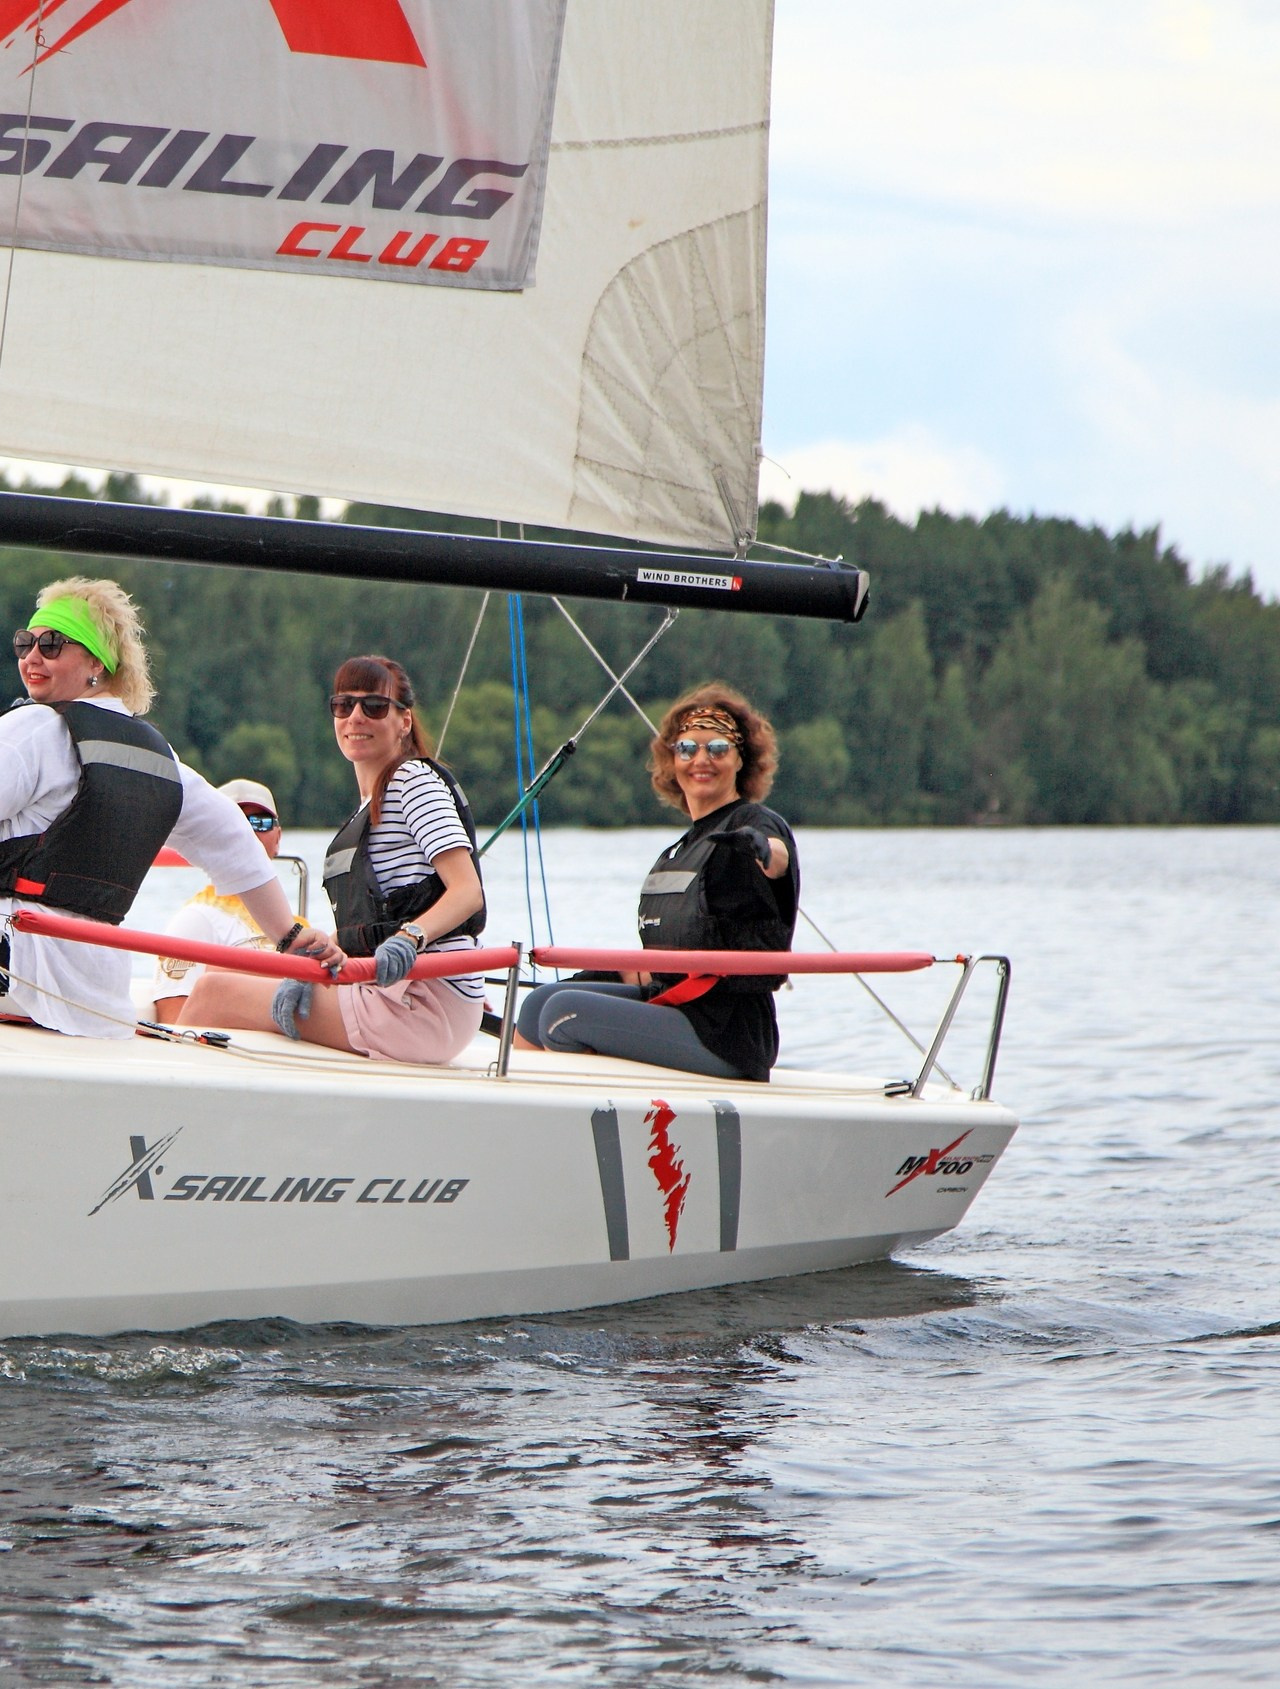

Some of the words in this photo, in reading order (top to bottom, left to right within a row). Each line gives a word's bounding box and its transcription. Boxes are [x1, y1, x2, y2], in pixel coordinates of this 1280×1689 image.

[276, 221, 490, 273] CLUB
[642, 571, 671, 582] WIND
[673, 574, 728, 587] BROTHERS
[163, 1175, 355, 1204] SAILING
[355, 1178, 471, 1204] CLUB
